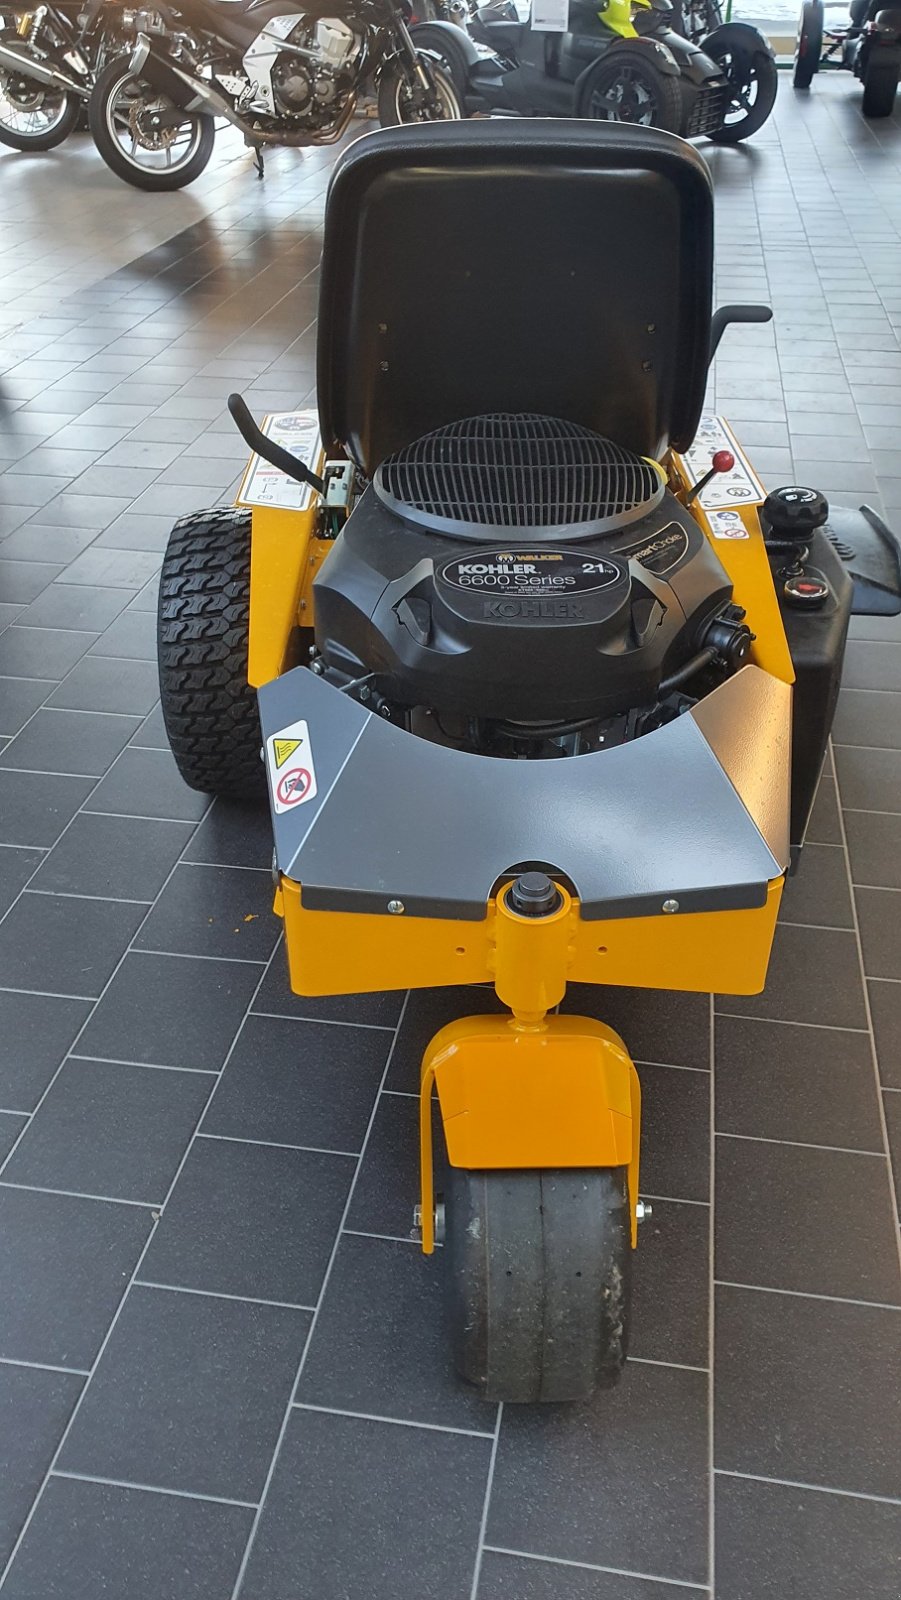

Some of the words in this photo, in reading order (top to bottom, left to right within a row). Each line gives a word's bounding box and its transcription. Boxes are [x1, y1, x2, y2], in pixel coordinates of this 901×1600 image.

[630, 534, 682, 560] martChoke
[458, 564, 537, 574] KOHLER
[582, 563, 604, 573] 21
[458, 575, 510, 586] 6600
[514, 574, 577, 586] Series
[483, 602, 584, 618] KOHLER
